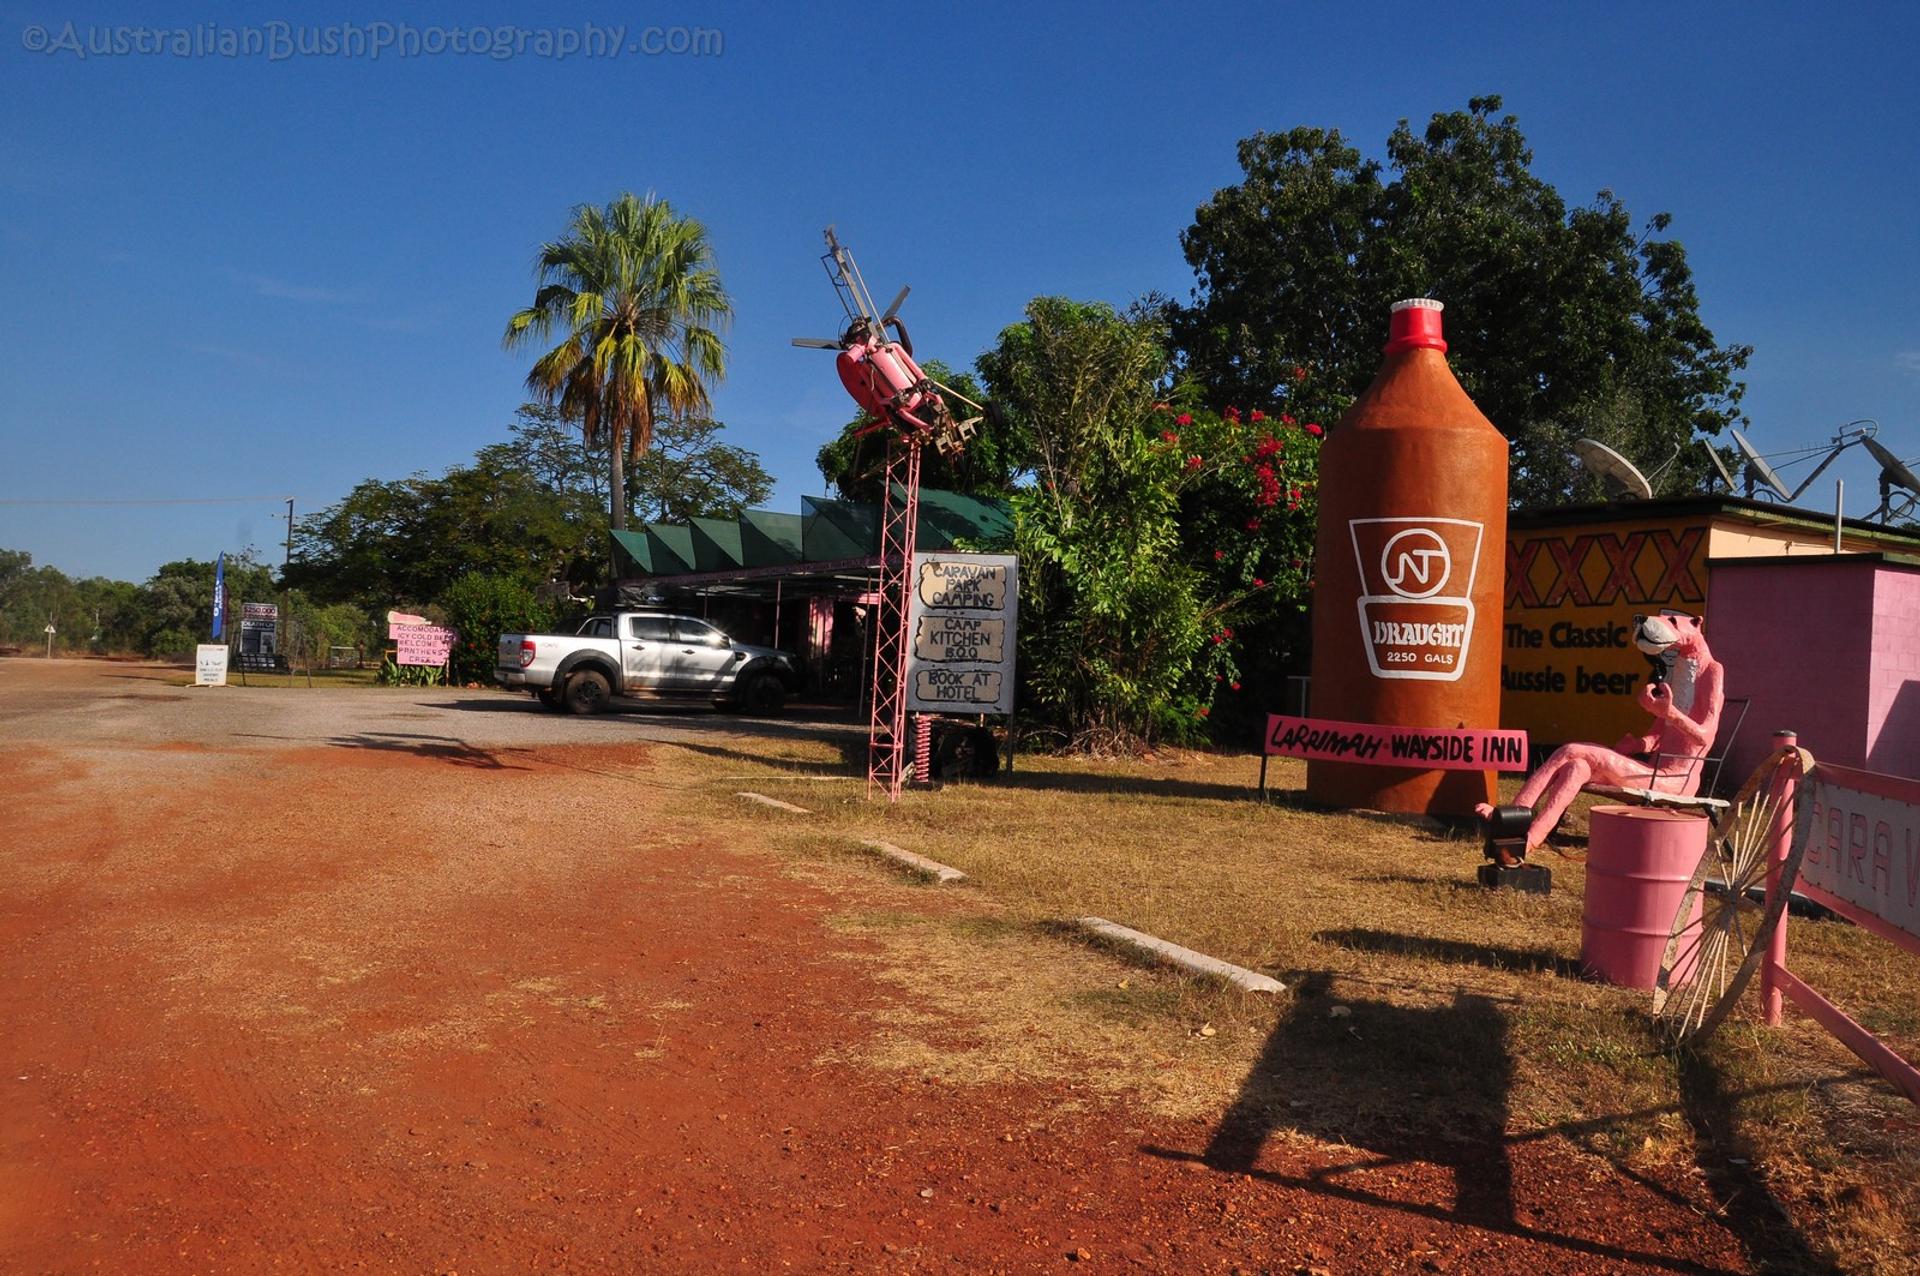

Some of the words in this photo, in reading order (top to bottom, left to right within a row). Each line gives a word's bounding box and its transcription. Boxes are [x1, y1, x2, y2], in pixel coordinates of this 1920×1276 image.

[933, 565, 996, 579] CARAVAN
[945, 579, 982, 592] PARK
[932, 592, 995, 607] CAMPING
[944, 618, 982, 630] CAMP
[930, 630, 991, 646] KITCHEN
[1373, 621, 1465, 648] DRAUGHT
[1505, 622, 1544, 648] The
[1549, 621, 1628, 649] Classic
[1387, 651, 1417, 662] 2250
[1424, 653, 1454, 665] GALS
[928, 670, 964, 685] BOOK
[972, 673, 992, 686] AT
[1576, 666, 1641, 695] beer
[936, 685, 979, 700] HOTEL
[1391, 733, 1474, 763] WAYSIDE
[1481, 735, 1523, 764] INN
